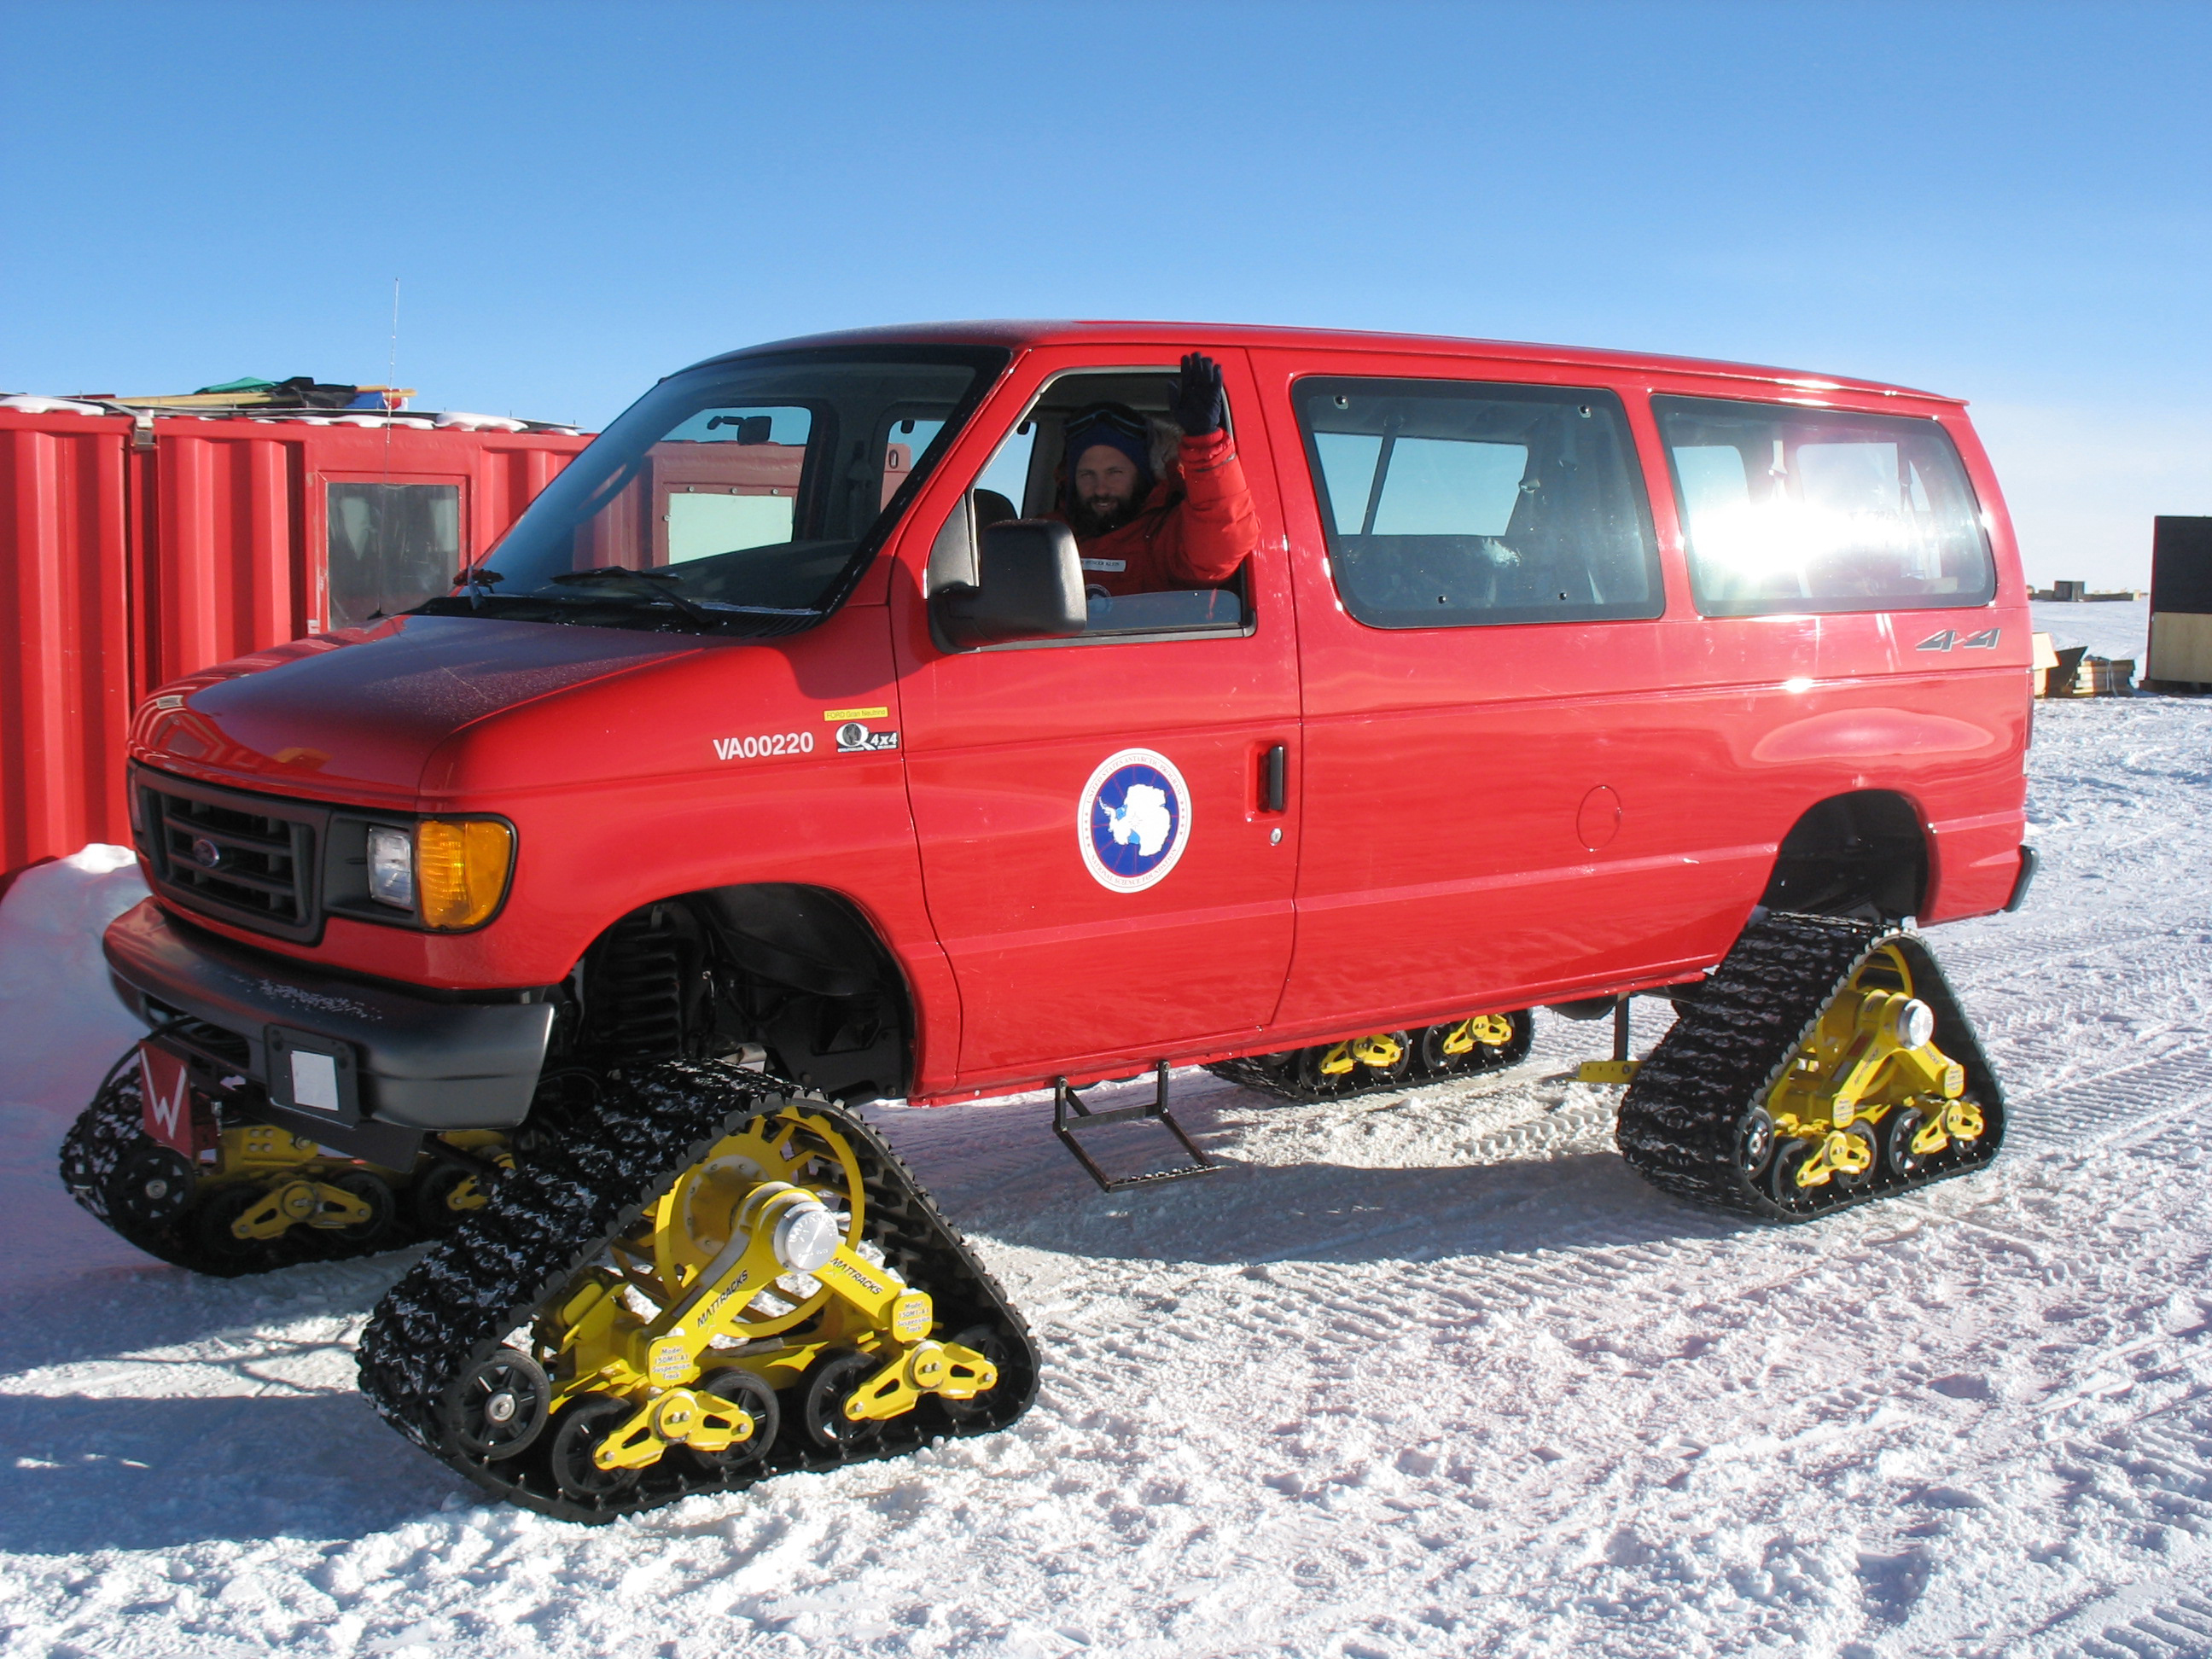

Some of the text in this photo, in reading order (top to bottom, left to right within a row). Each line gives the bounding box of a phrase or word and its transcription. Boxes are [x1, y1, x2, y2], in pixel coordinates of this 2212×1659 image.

[826, 711, 845, 719] FORD
[713, 731, 814, 760] VA00220
[870, 732, 898, 747] 4x4
[1086, 755, 1182, 804] UNITED STATES ANTARCTIC PROGRAM
[1090, 848, 1177, 886] NATIONAL SCIENCE FOUNDATION
[140, 1047, 187, 1139] W
[830, 1257, 883, 1295] MATTRACKS
[697, 1269, 748, 1329] MATTRACKS
[905, 1301, 923, 1309] Model
[897, 1316, 930, 1327] Suspension
[661, 1345, 683, 1353] Model
[652, 1363, 690, 1373] Suspension
[663, 1371, 680, 1380] Track
